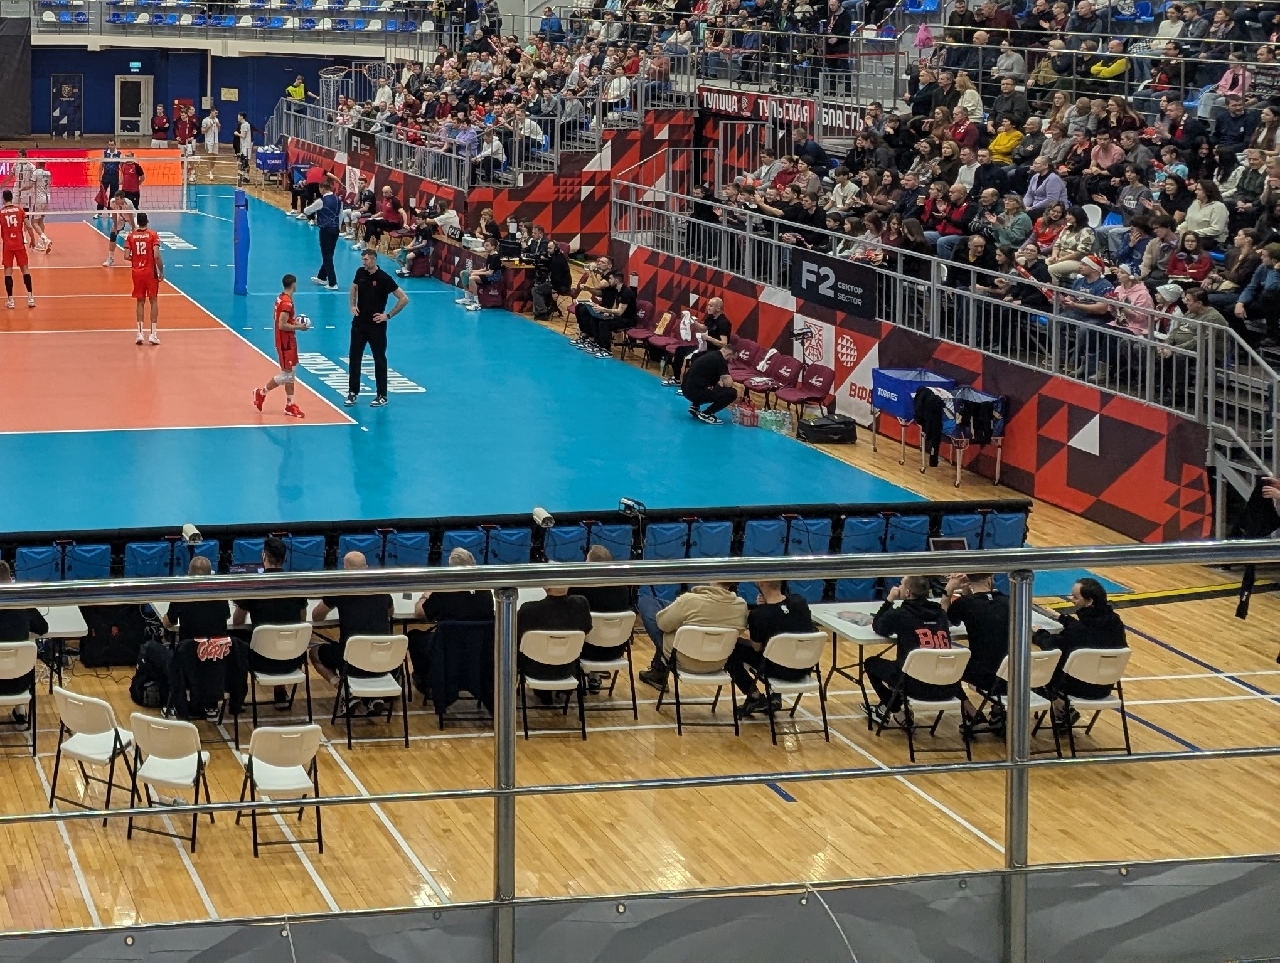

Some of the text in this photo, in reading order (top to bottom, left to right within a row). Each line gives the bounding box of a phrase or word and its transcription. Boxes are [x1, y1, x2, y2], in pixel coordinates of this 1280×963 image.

[702, 91, 738, 113] ТУЛИЦА
[758, 99, 863, 132] ТУЛЬСКАЯ БЛАСТЬ
[135, 241, 147, 256] 12
[801, 260, 835, 298] F2
[837, 281, 863, 295] СЕКТОР
[837, 292, 862, 306] SECTOR
